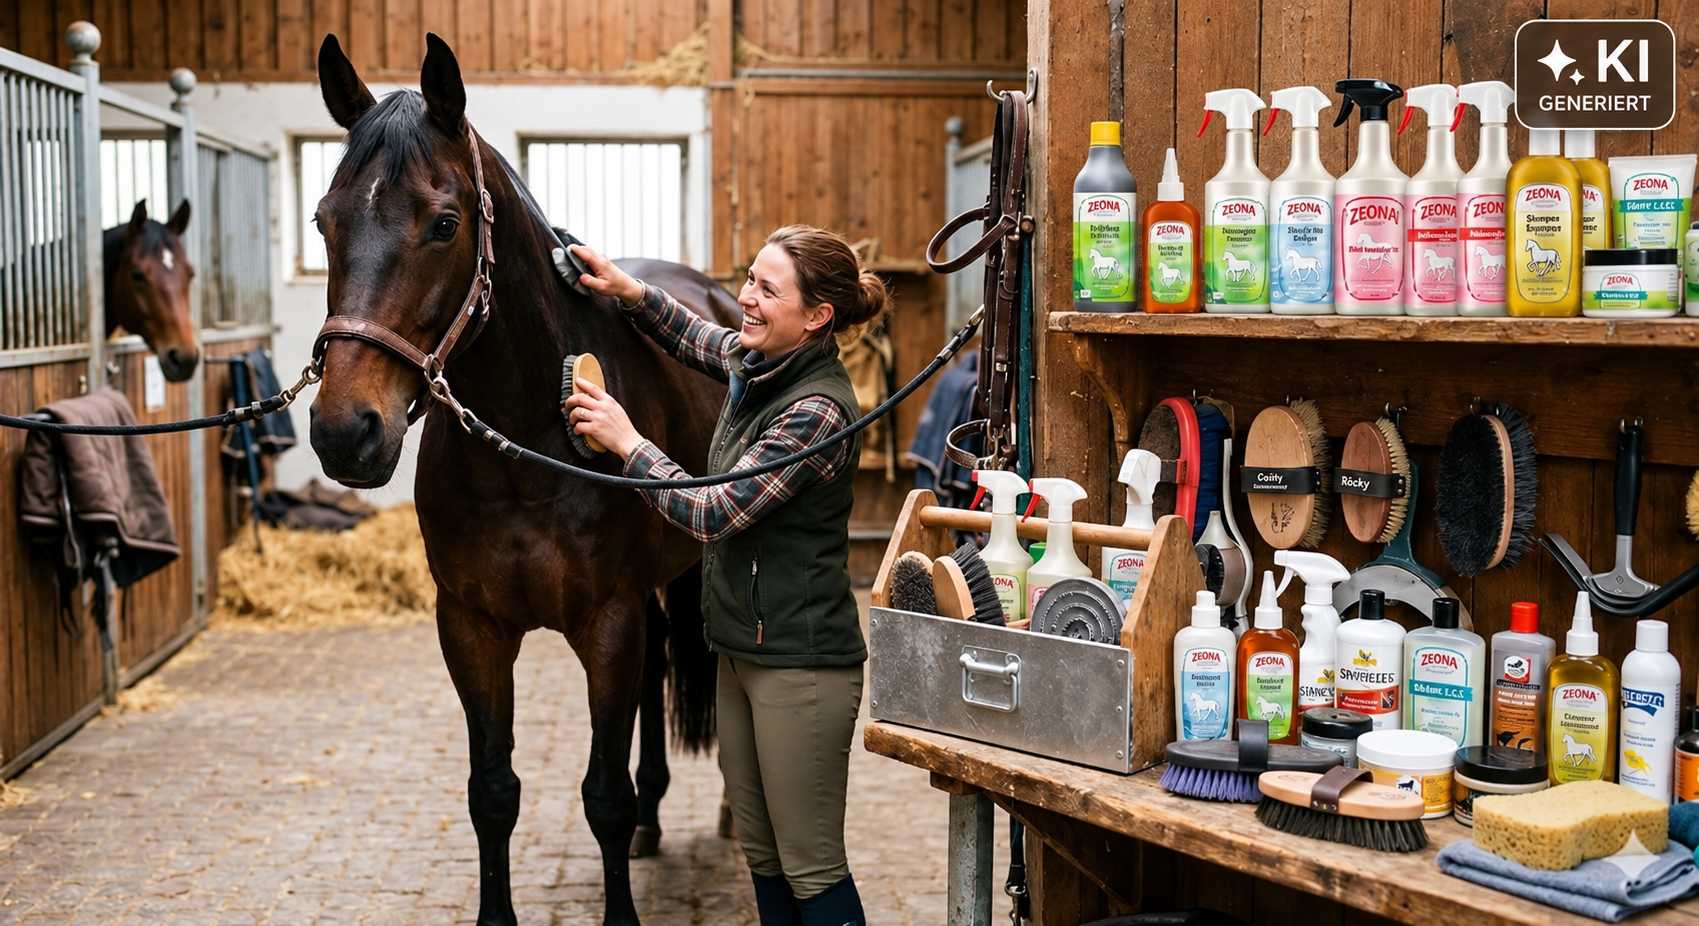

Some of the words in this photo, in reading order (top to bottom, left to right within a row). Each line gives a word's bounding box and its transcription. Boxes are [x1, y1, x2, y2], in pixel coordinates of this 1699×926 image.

[1633, 177, 1669, 191] ZEONA
[1525, 187, 1562, 202] ZEONA
[1087, 200, 1121, 213] ZEONA
[1222, 203, 1256, 216] ZEONA
[1287, 202, 1322, 216] ZEONA
[1421, 203, 1457, 220] ZEONA
[1473, 201, 1505, 218] ZEON
[1349, 205, 1399, 225] ZEONA
[1156, 224, 1185, 236] ZEONA
[1607, 273, 1633, 286] ZEONA
[1117, 558, 1144, 570] ZEONA
[992, 576, 1014, 589] ONA
[1191, 651, 1221, 663] ZEONA
[1255, 656, 1285, 667] ZEONA
[1421, 653, 1458, 669] ZEONA
[1562, 688, 1598, 702] ZEONA
